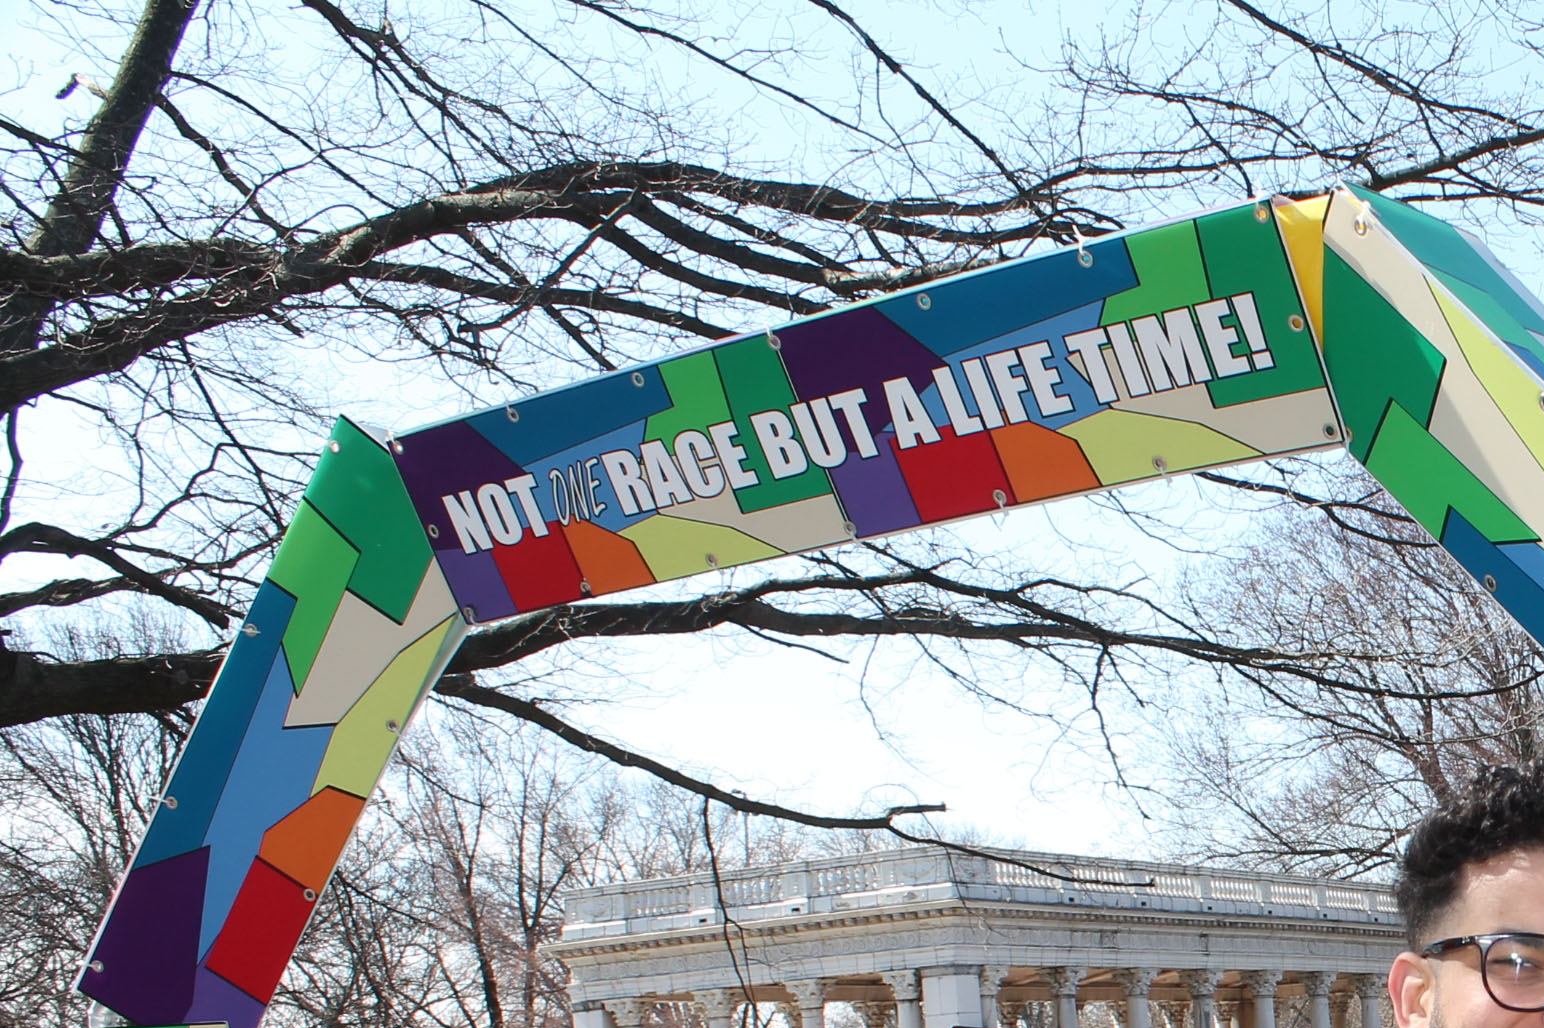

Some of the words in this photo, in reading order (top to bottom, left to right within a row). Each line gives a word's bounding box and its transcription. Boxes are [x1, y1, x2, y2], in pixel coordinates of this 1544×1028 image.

[442, 472, 551, 555] NOT
[548, 455, 608, 526] ONE
[600, 420, 760, 517] RACE
[749, 387, 880, 480] BUT
[882, 376, 942, 450] A
[931, 339, 1075, 437] LIFE
[1062, 290, 1278, 406] TIME!
